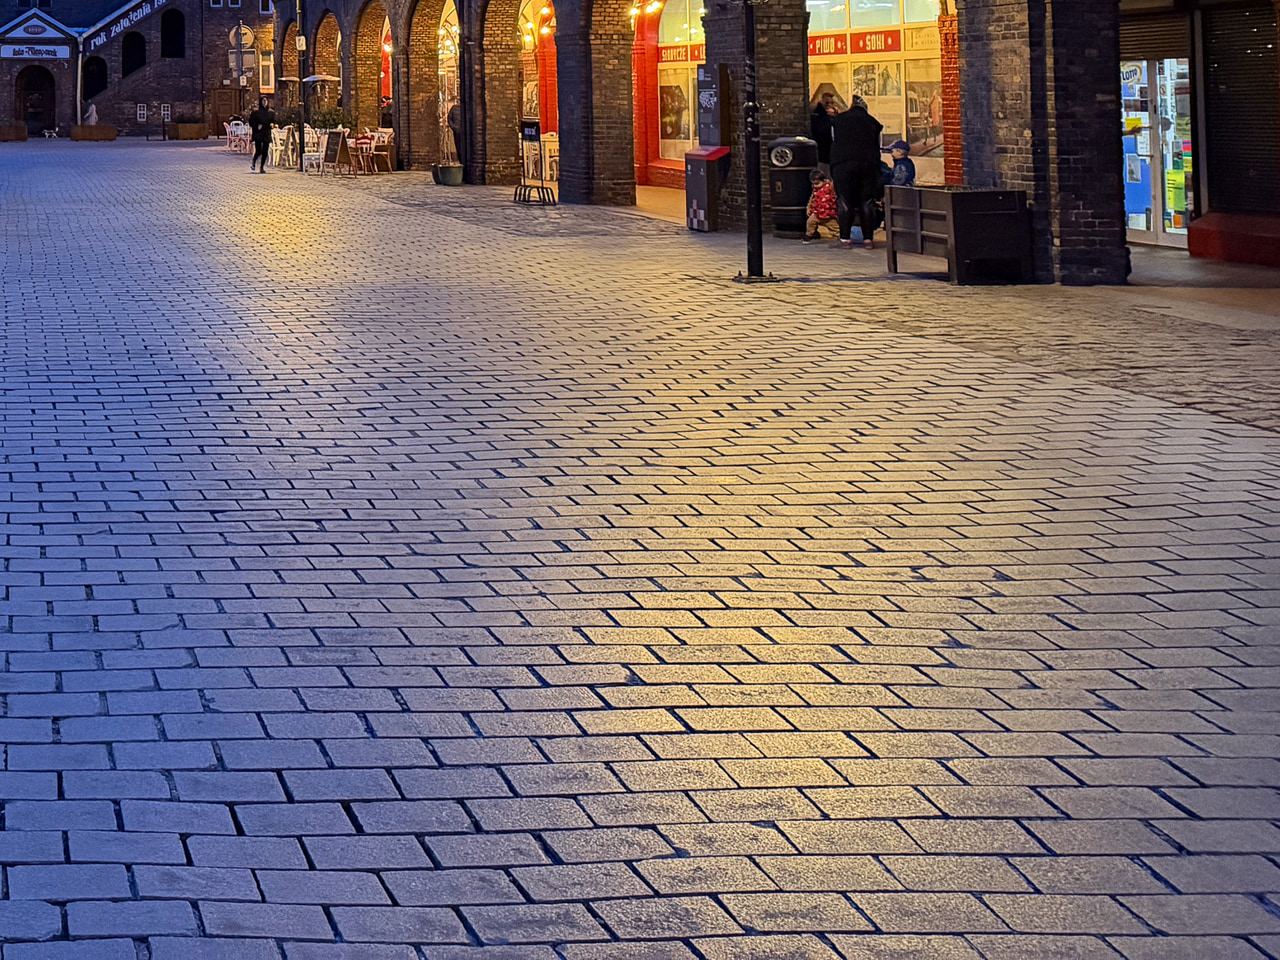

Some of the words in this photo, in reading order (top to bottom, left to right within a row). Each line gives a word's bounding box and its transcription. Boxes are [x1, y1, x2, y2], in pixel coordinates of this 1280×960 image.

[91, 32, 107, 50] rok
[815, 37, 835, 53] PIWO
[865, 34, 885, 51] SOKI
[1121, 68, 1138, 81] LOTTO
